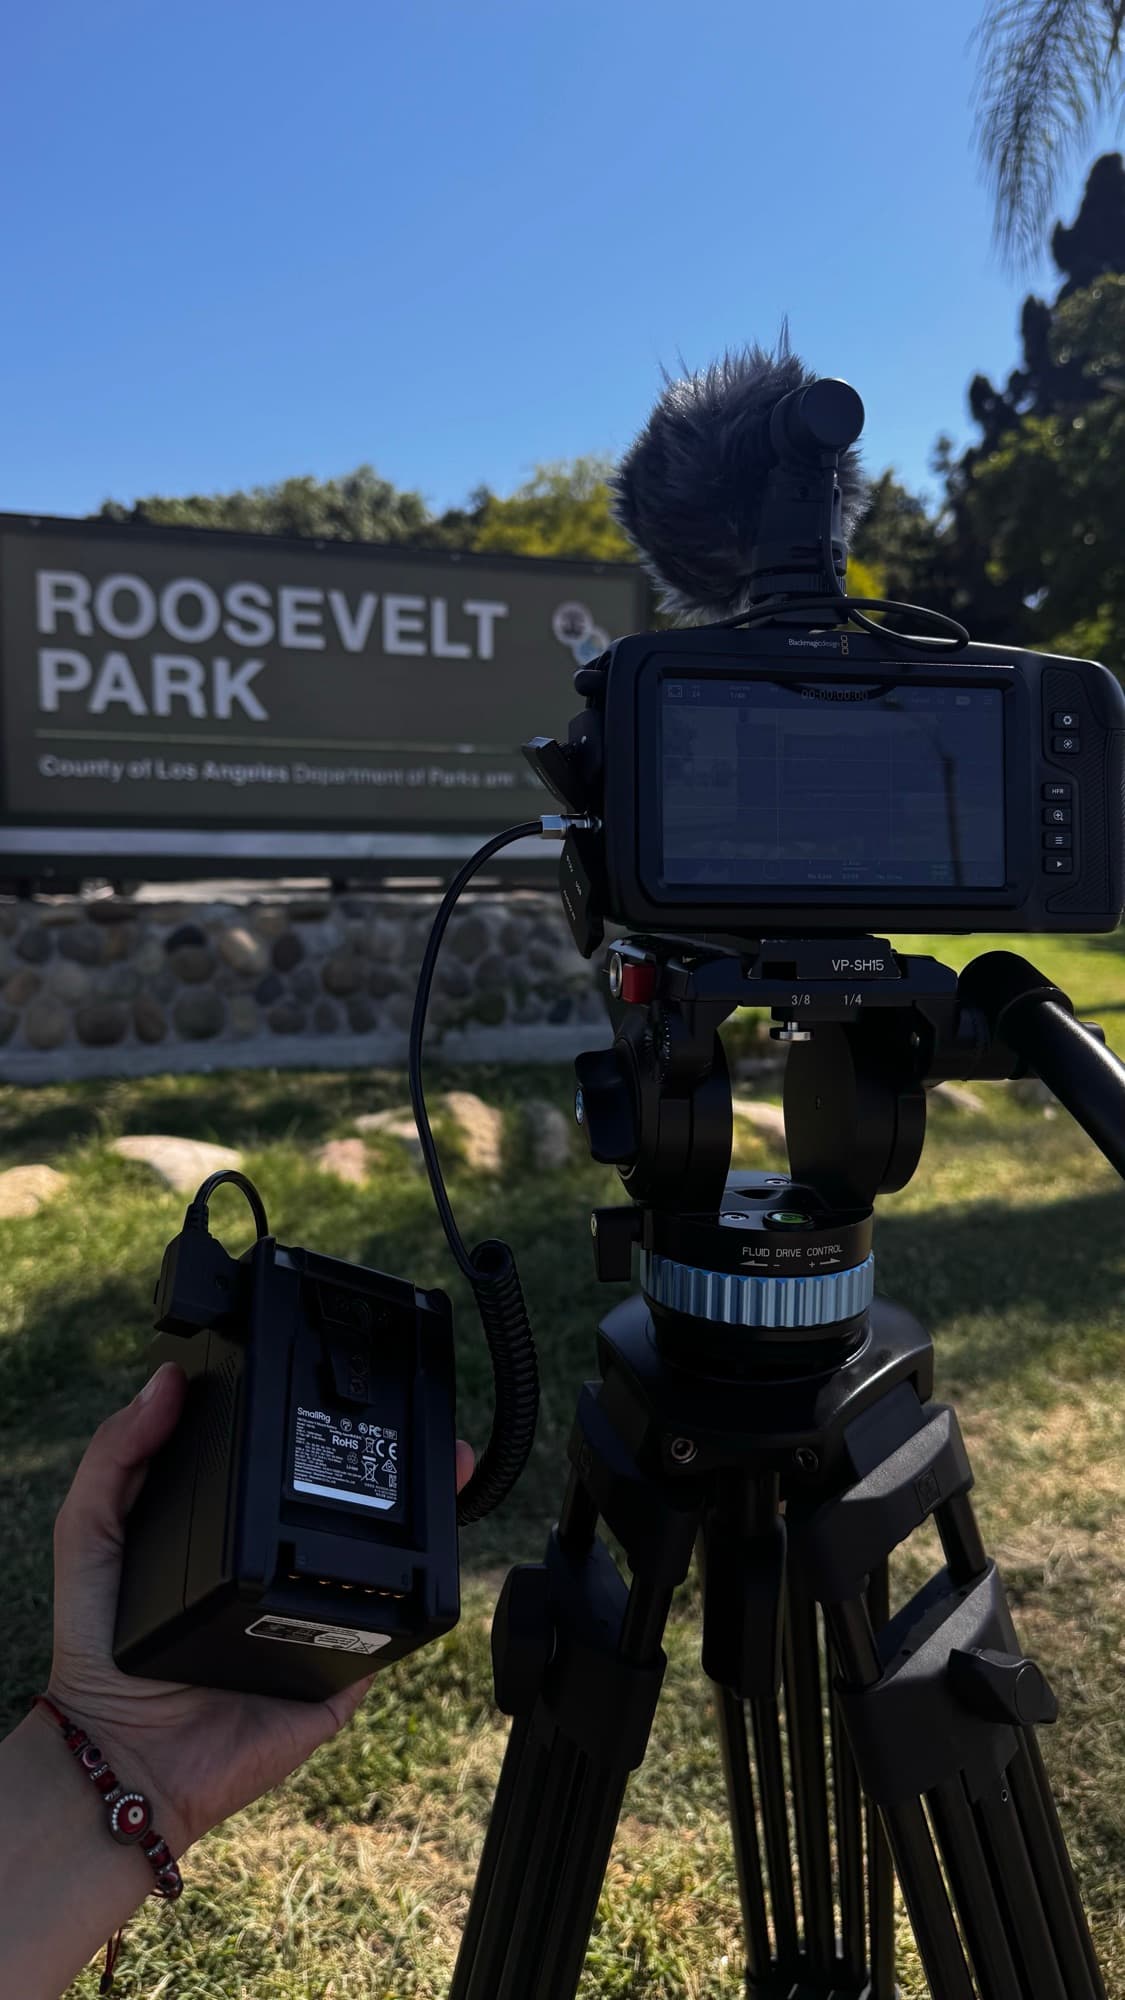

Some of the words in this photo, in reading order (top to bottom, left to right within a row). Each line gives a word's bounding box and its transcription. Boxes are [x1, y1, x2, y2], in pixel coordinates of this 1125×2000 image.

[35, 569, 509, 661] ROOSEVELT
[38, 648, 269, 721] PARK
[39, 755, 123, 783] County
[127, 759, 151, 779] of
[155, 757, 198, 780] Los
[203, 760, 290, 786] Angeles
[293, 761, 402, 787] Department
[406, 766, 428, 785] of
[430, 766, 482, 787] Parks
[1051, 787, 1065, 795] HFR
[831, 958, 886, 972] VP-SH15
[791, 994, 811, 1006] 3/8
[843, 994, 863, 1006] 1/4
[741, 1246, 771, 1258] FLUID
[775, 1247, 802, 1258] DRIVE
[806, 1244, 844, 1257] CONTROL
[297, 1406, 331, 1424] SmallRig
[331, 1434, 359, 1450] RoHS
